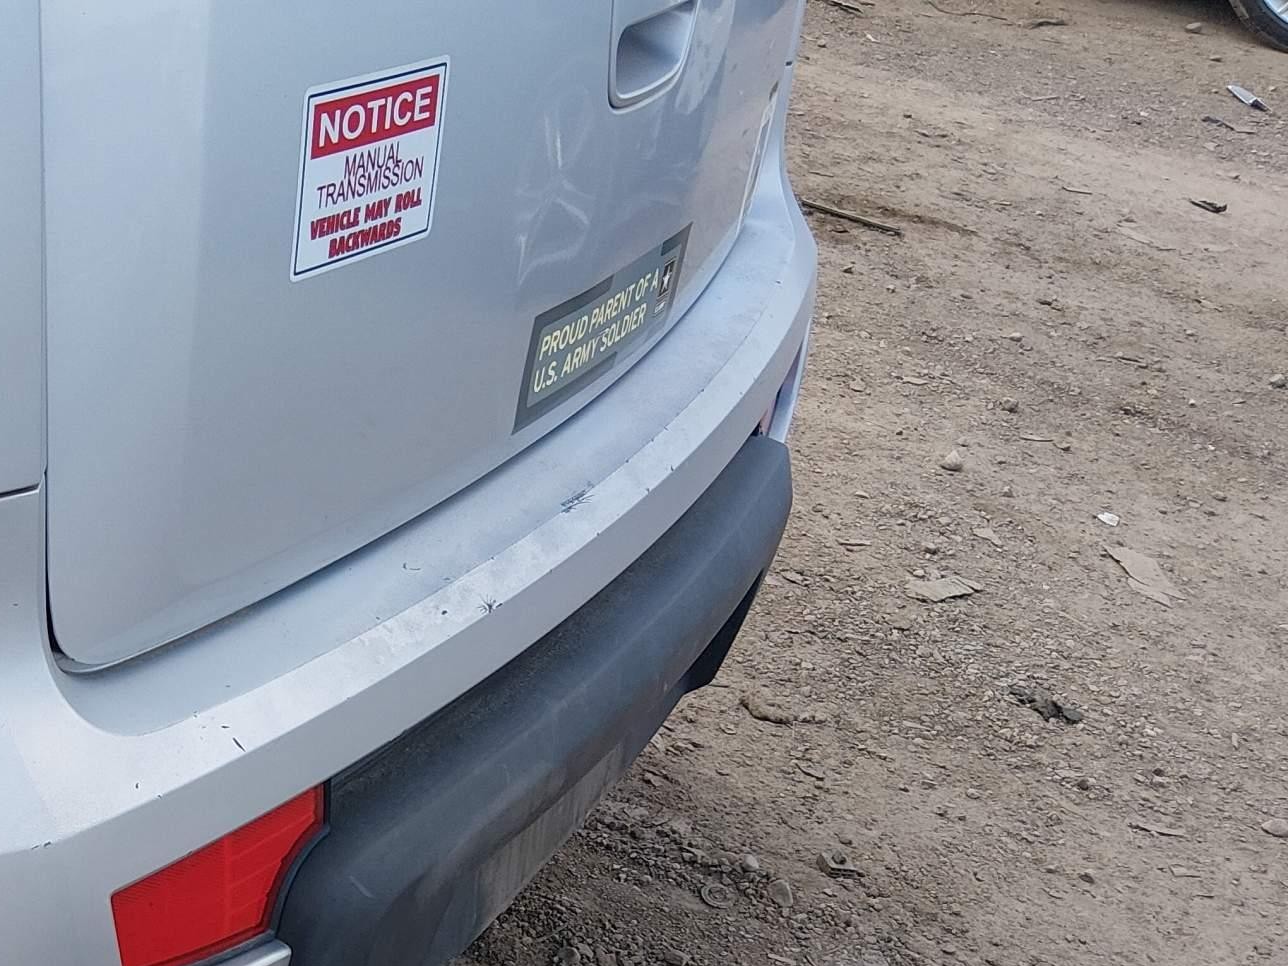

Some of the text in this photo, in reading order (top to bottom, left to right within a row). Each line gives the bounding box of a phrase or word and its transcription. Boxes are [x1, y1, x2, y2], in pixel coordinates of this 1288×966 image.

[318, 85, 433, 148] NOTICE
[316, 156, 425, 209] TRANSMISSION
[344, 141, 402, 179] MANUAL
[310, 187, 422, 241] VEHICLE MAY ROLL
[328, 217, 402, 259] BACKWARDS
[539, 313, 588, 361] PROUD
[588, 284, 636, 333] PARENT
[634, 272, 652, 301] OF
[649, 267, 660, 292] A
[533, 361, 558, 393] U.S.
[560, 336, 600, 378] ARMY
[599, 303, 648, 352] SOLDIER
